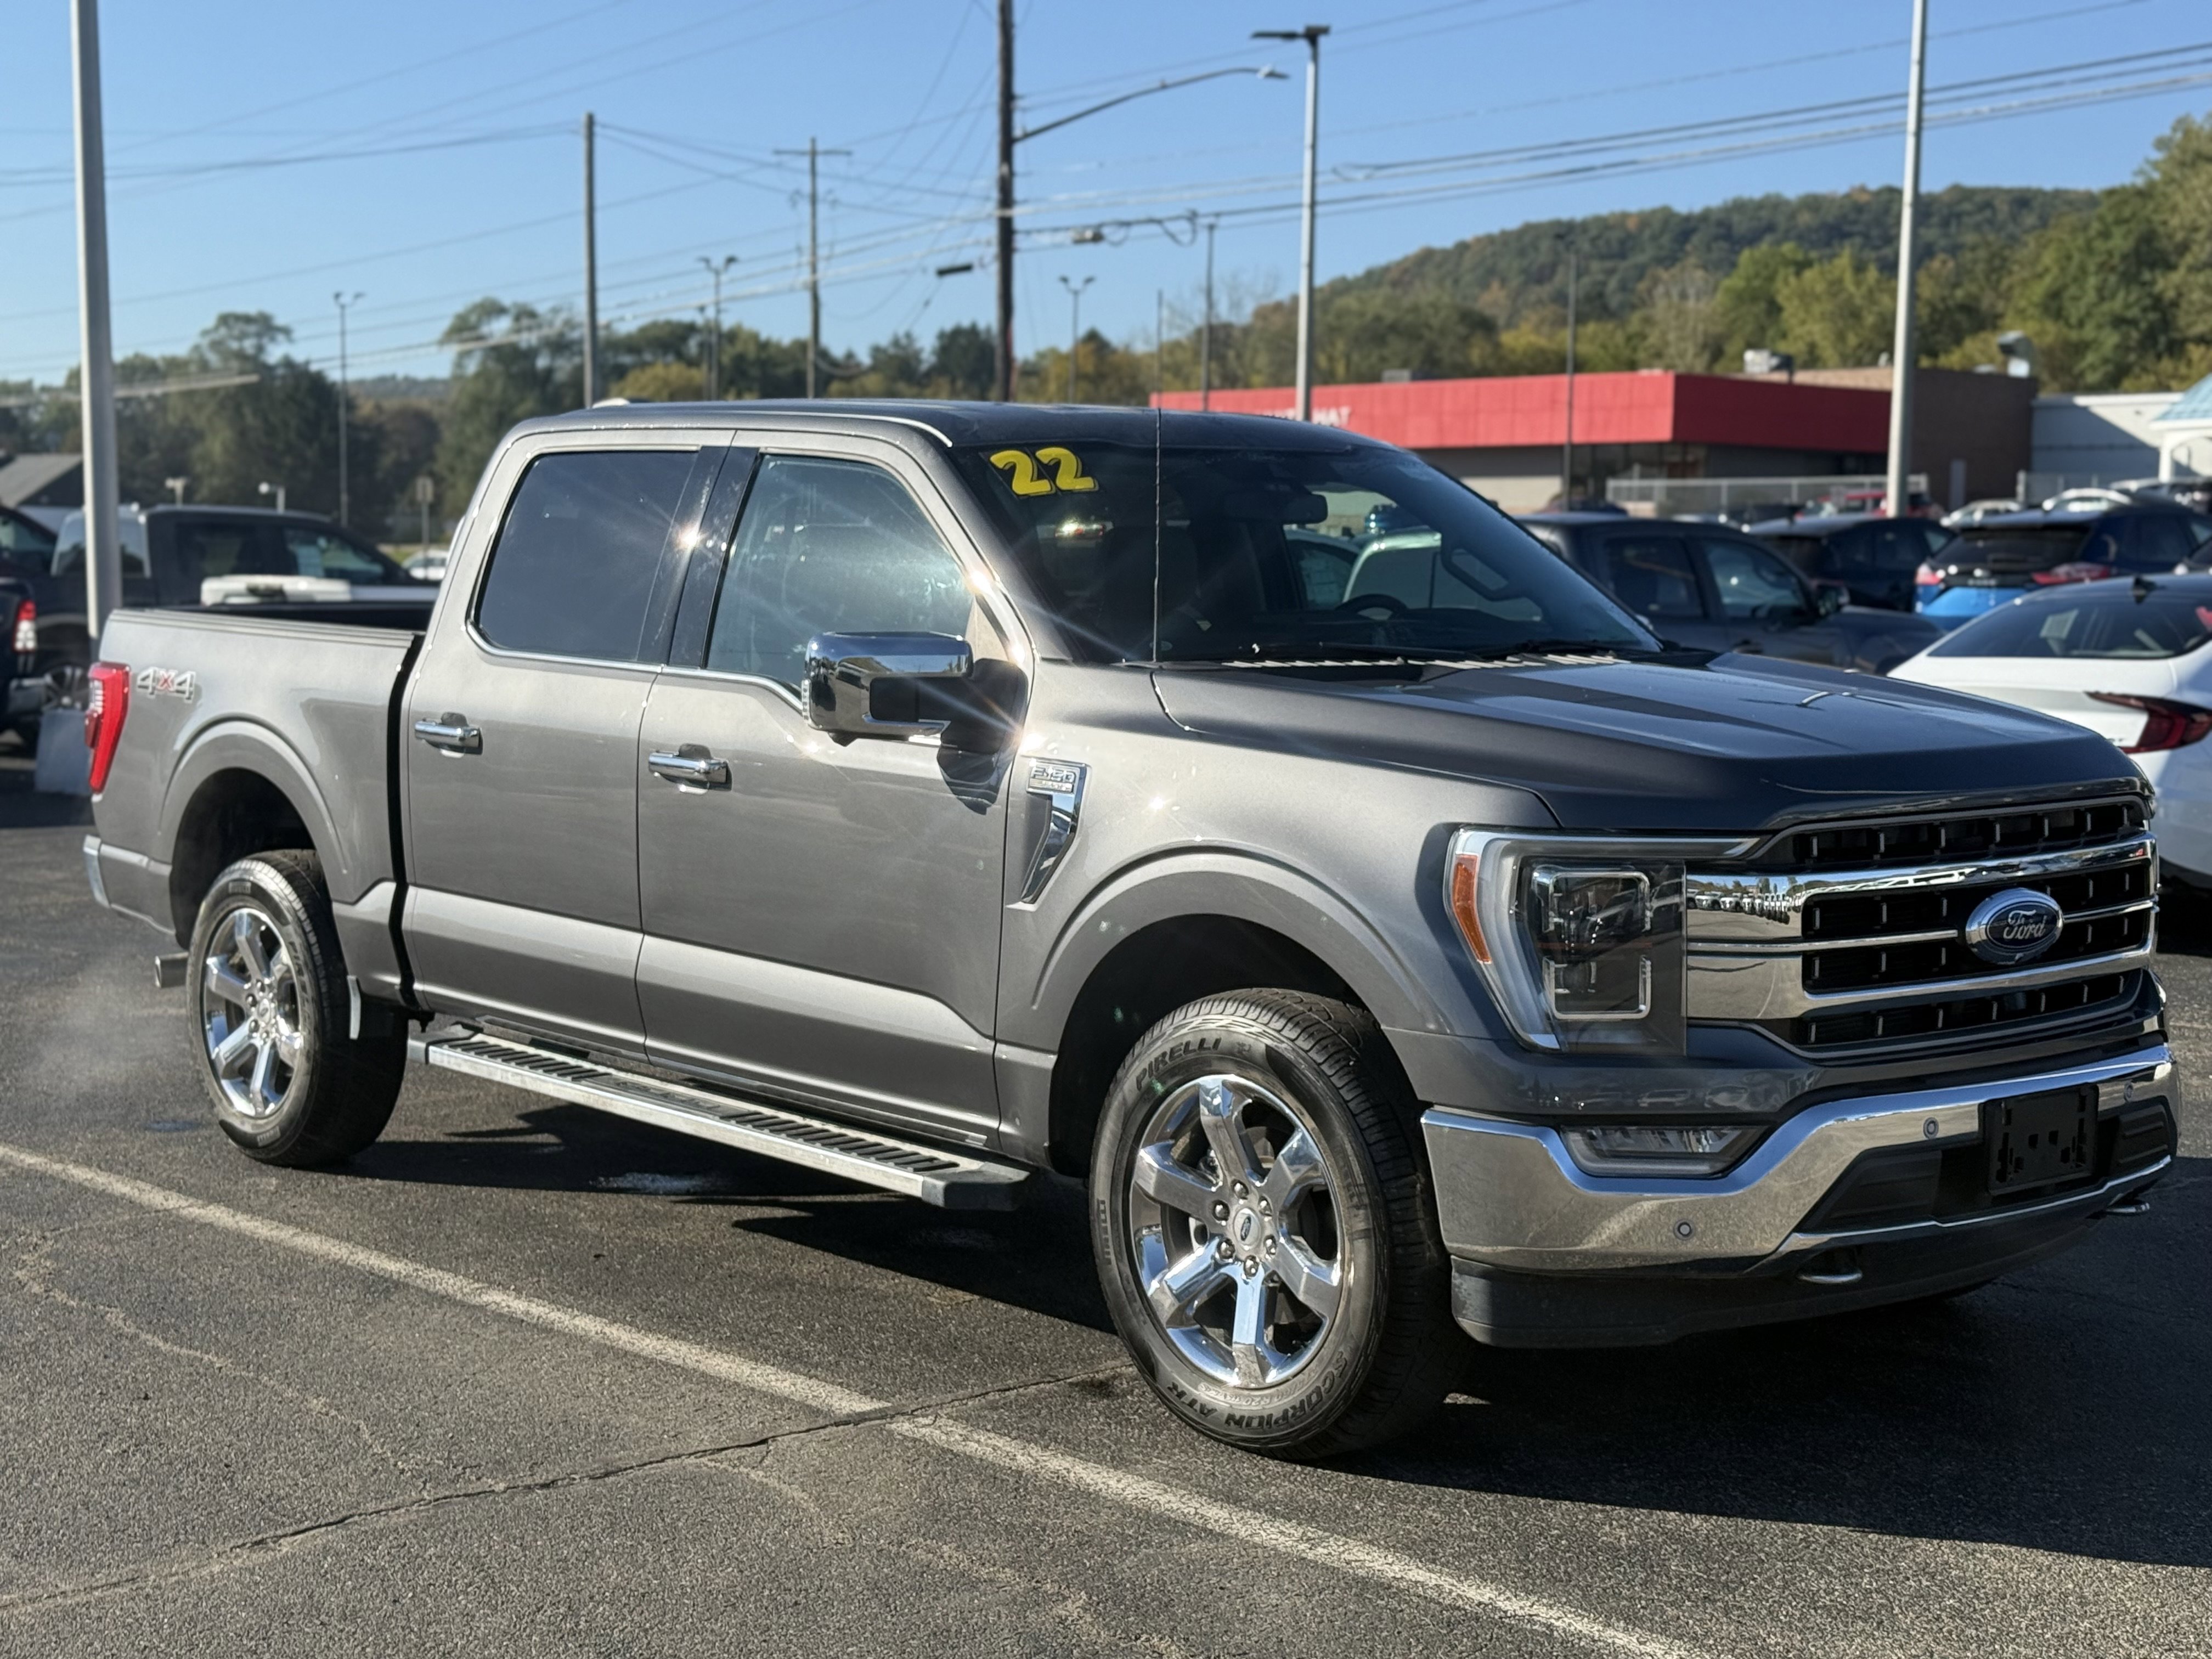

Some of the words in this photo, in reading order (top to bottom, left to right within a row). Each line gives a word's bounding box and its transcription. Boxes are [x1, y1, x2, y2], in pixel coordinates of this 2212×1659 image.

[989, 447, 1098, 497] 22
[2003, 909, 2047, 940] Ford
[1136, 1036, 1222, 1092] PIRELLI
[1224, 1350, 1347, 1430] SCORPION
